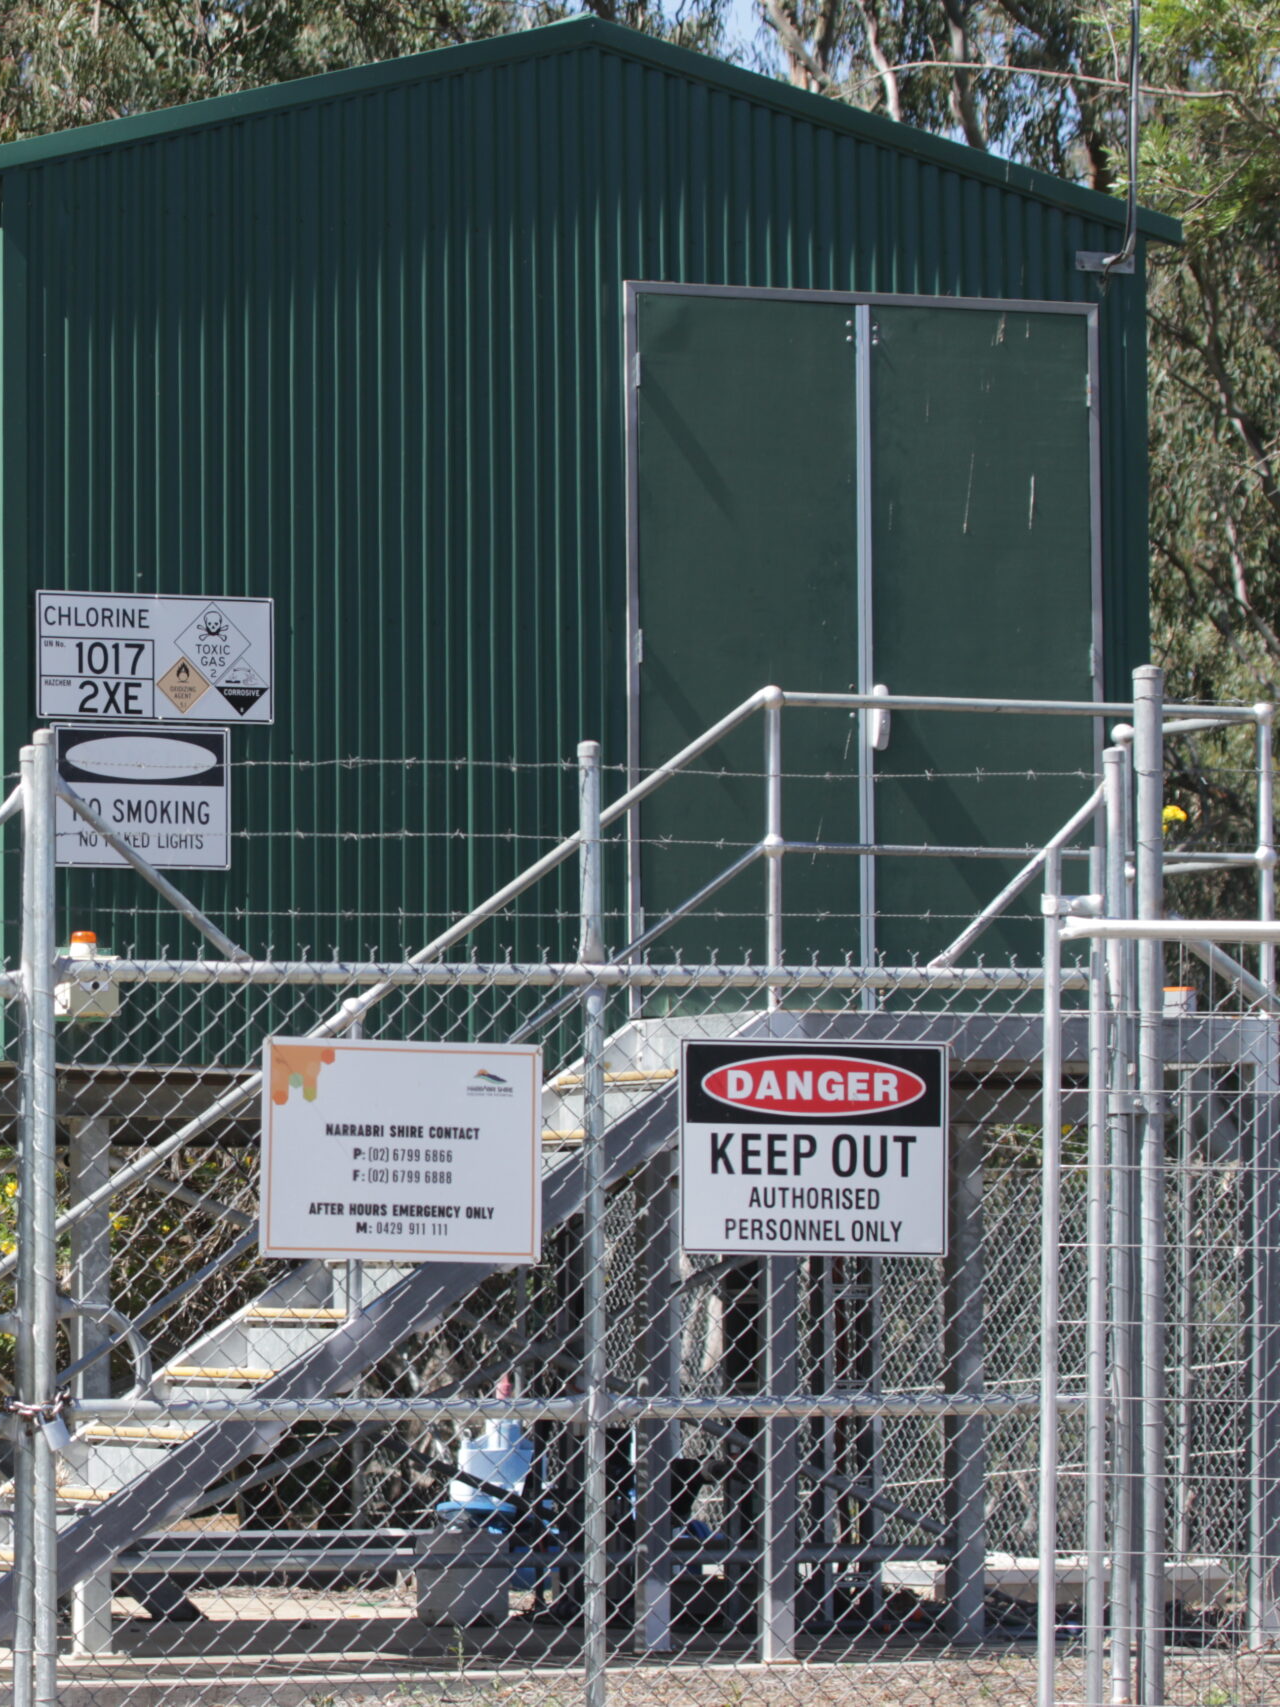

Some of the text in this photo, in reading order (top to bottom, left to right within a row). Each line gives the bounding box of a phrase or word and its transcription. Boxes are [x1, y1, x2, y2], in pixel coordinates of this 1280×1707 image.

[44, 606, 149, 628] CHLORINE
[196, 644, 230, 656] TOXIC
[76, 642, 145, 675] 1017
[201, 657, 226, 667] GAS
[210, 669, 217, 678] 2
[44, 679, 72, 687] HAZCHEM
[78, 681, 142, 714] 2XE
[224, 689, 260, 697] CORROSIVE
[112, 799, 209, 825] SMOKING
[158, 833, 203, 849] LIGHTS
[727, 1070, 899, 1102] DANGER
[326, 1124, 480, 1140] NARRABRI SHIRE CONTACT
[353, 1147, 452, 1163] P: (02) 6799 6866
[710, 1133, 916, 1177] KEEP OUT
[353, 1169, 452, 1184] F: (02) 6799 6888
[749, 1187, 880, 1209] AUTHORISED
[309, 1202, 494, 1219] AFTER HOURS EMERGENCY ONLY
[356, 1222, 448, 1236] M: 0429 911 111
[725, 1219, 902, 1242] PERSONNEL ONLY
